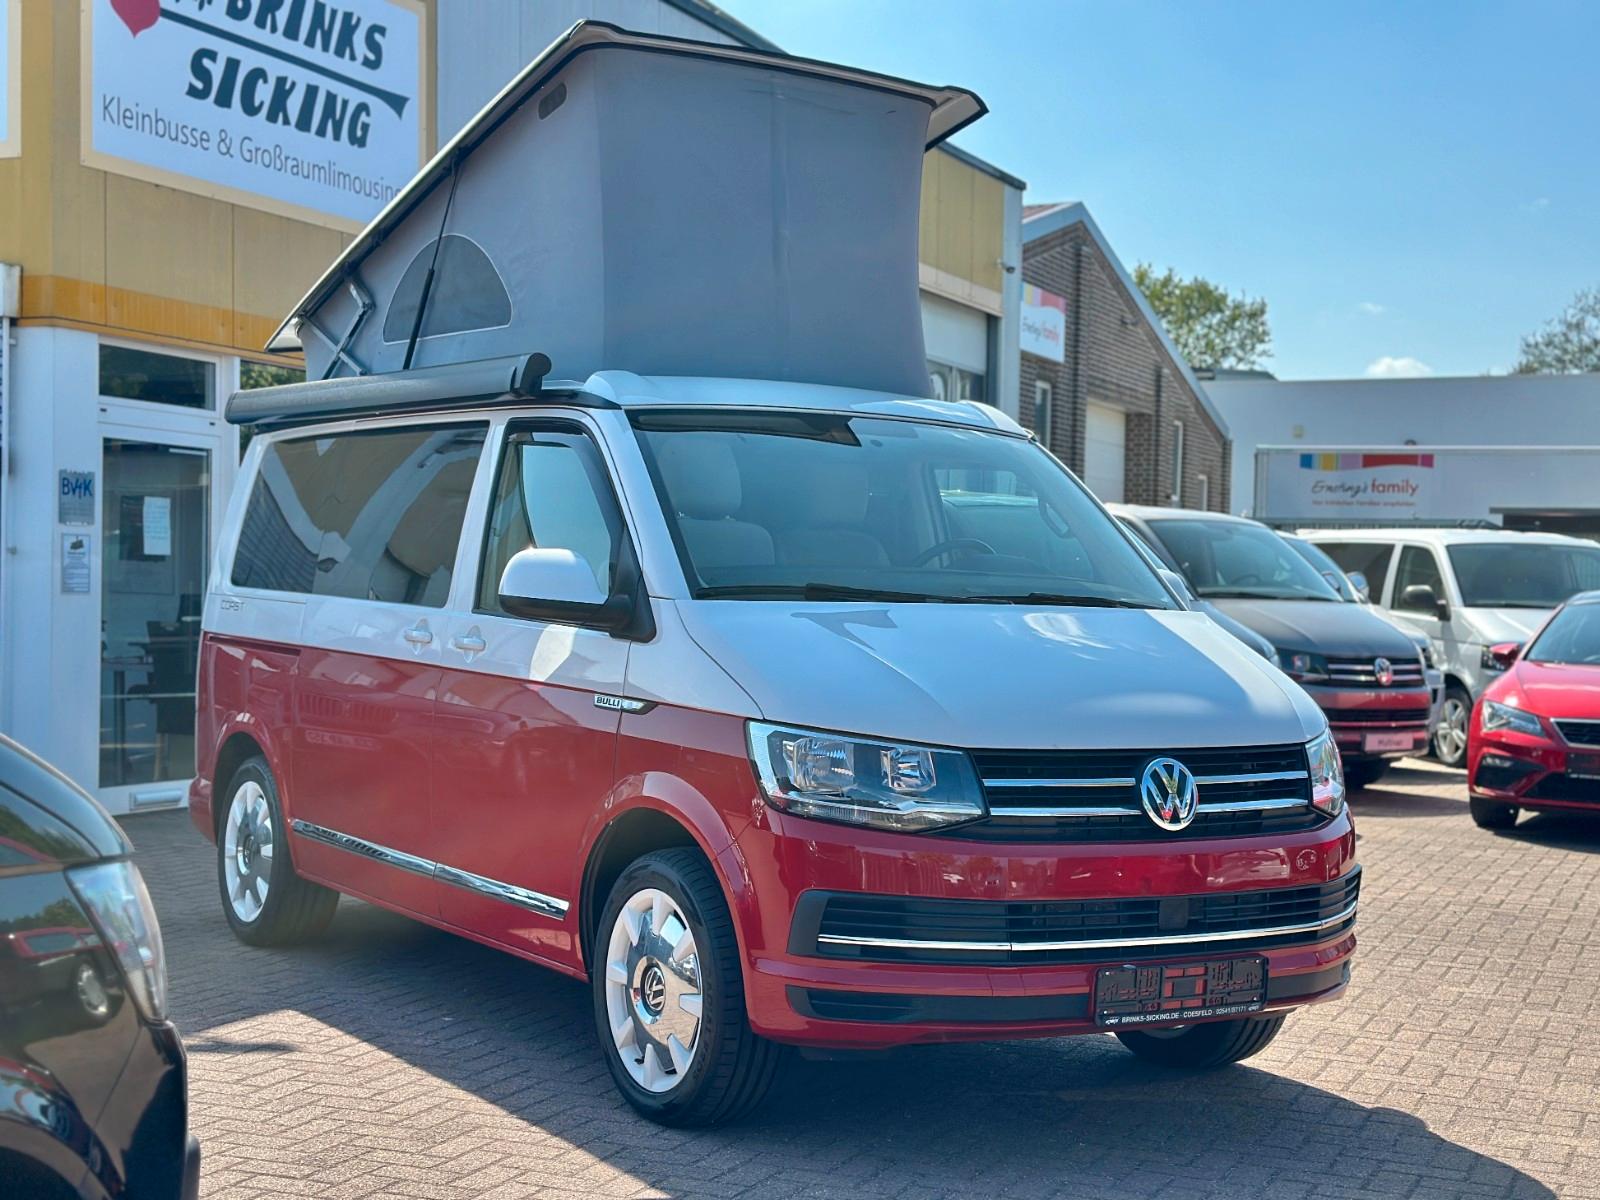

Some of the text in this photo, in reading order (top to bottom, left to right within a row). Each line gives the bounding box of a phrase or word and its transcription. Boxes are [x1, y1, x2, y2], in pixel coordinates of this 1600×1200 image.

[185, 47, 371, 149] SICKING
[102, 94, 402, 202] Kleinbusse & Großraumlimousin
[1371, 478, 1418, 497] family
[596, 696, 620, 707] BULLI
[1183, 1009, 1213, 1018] COESFELD
